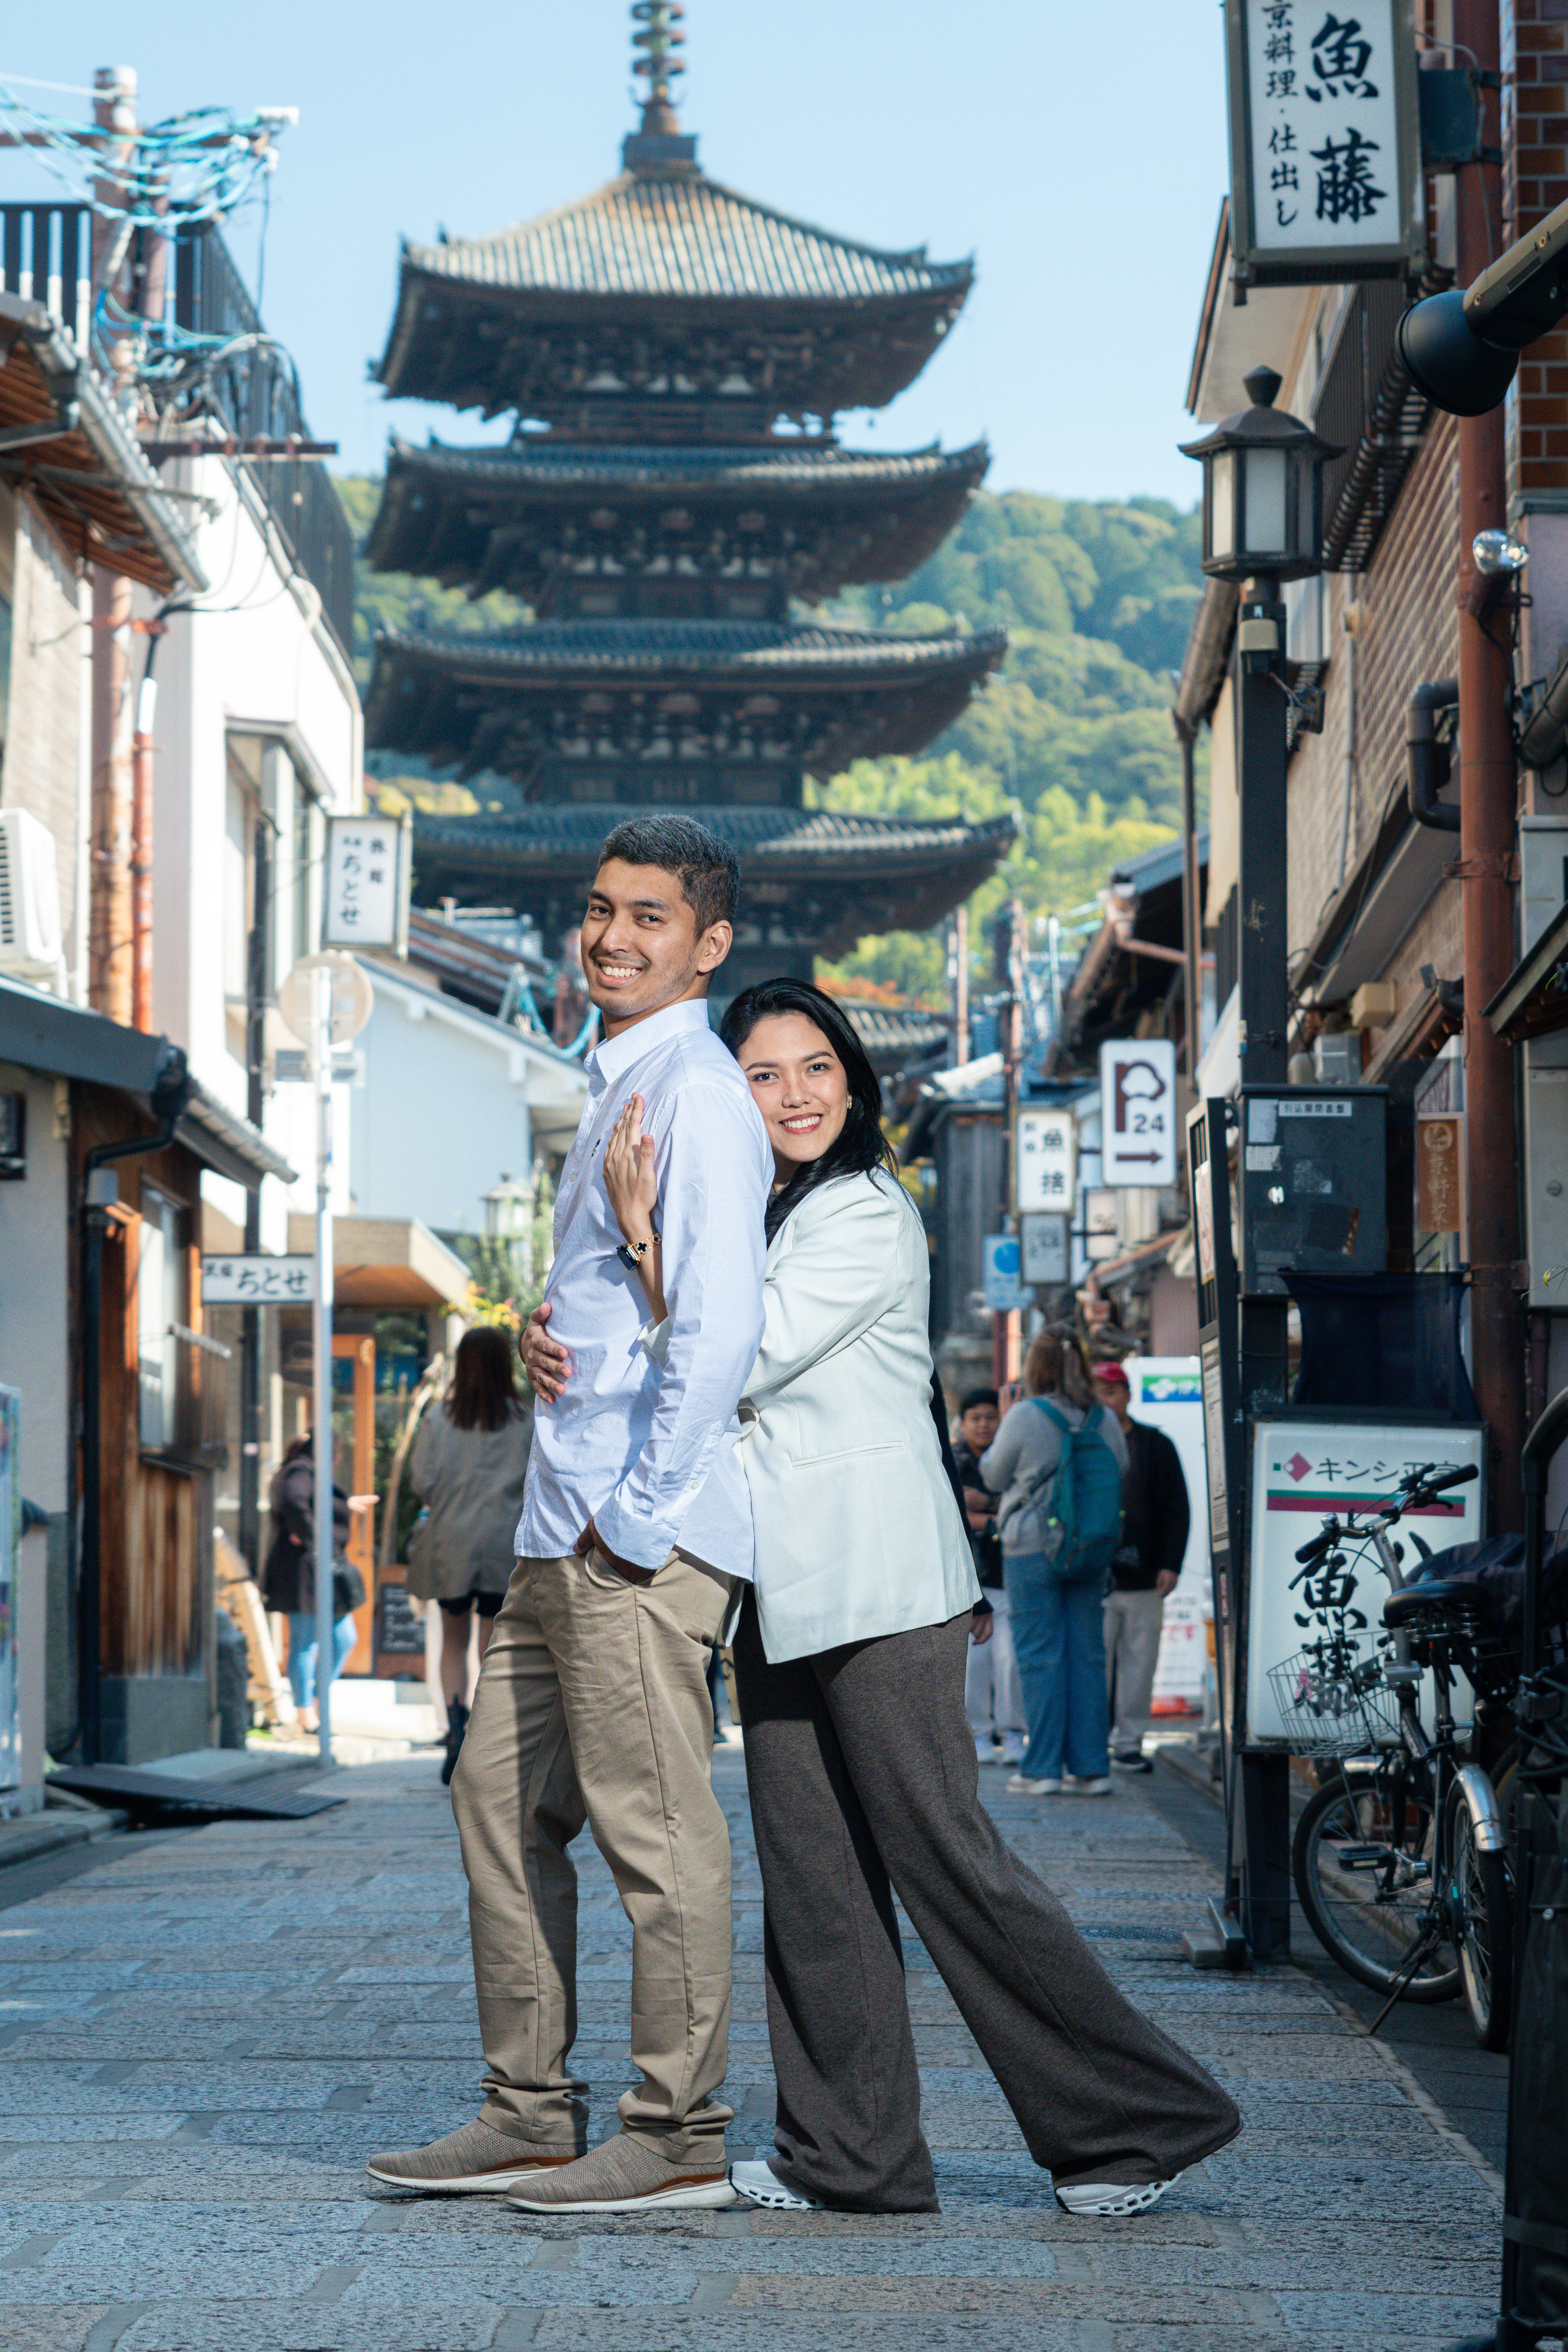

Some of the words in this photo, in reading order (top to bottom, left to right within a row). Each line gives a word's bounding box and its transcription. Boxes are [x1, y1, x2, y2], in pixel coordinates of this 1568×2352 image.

[1305, 12, 1388, 224] 魚藤
[1134, 1114, 1164, 1133] 24
[237, 1267, 308, 1294] ちとせ
